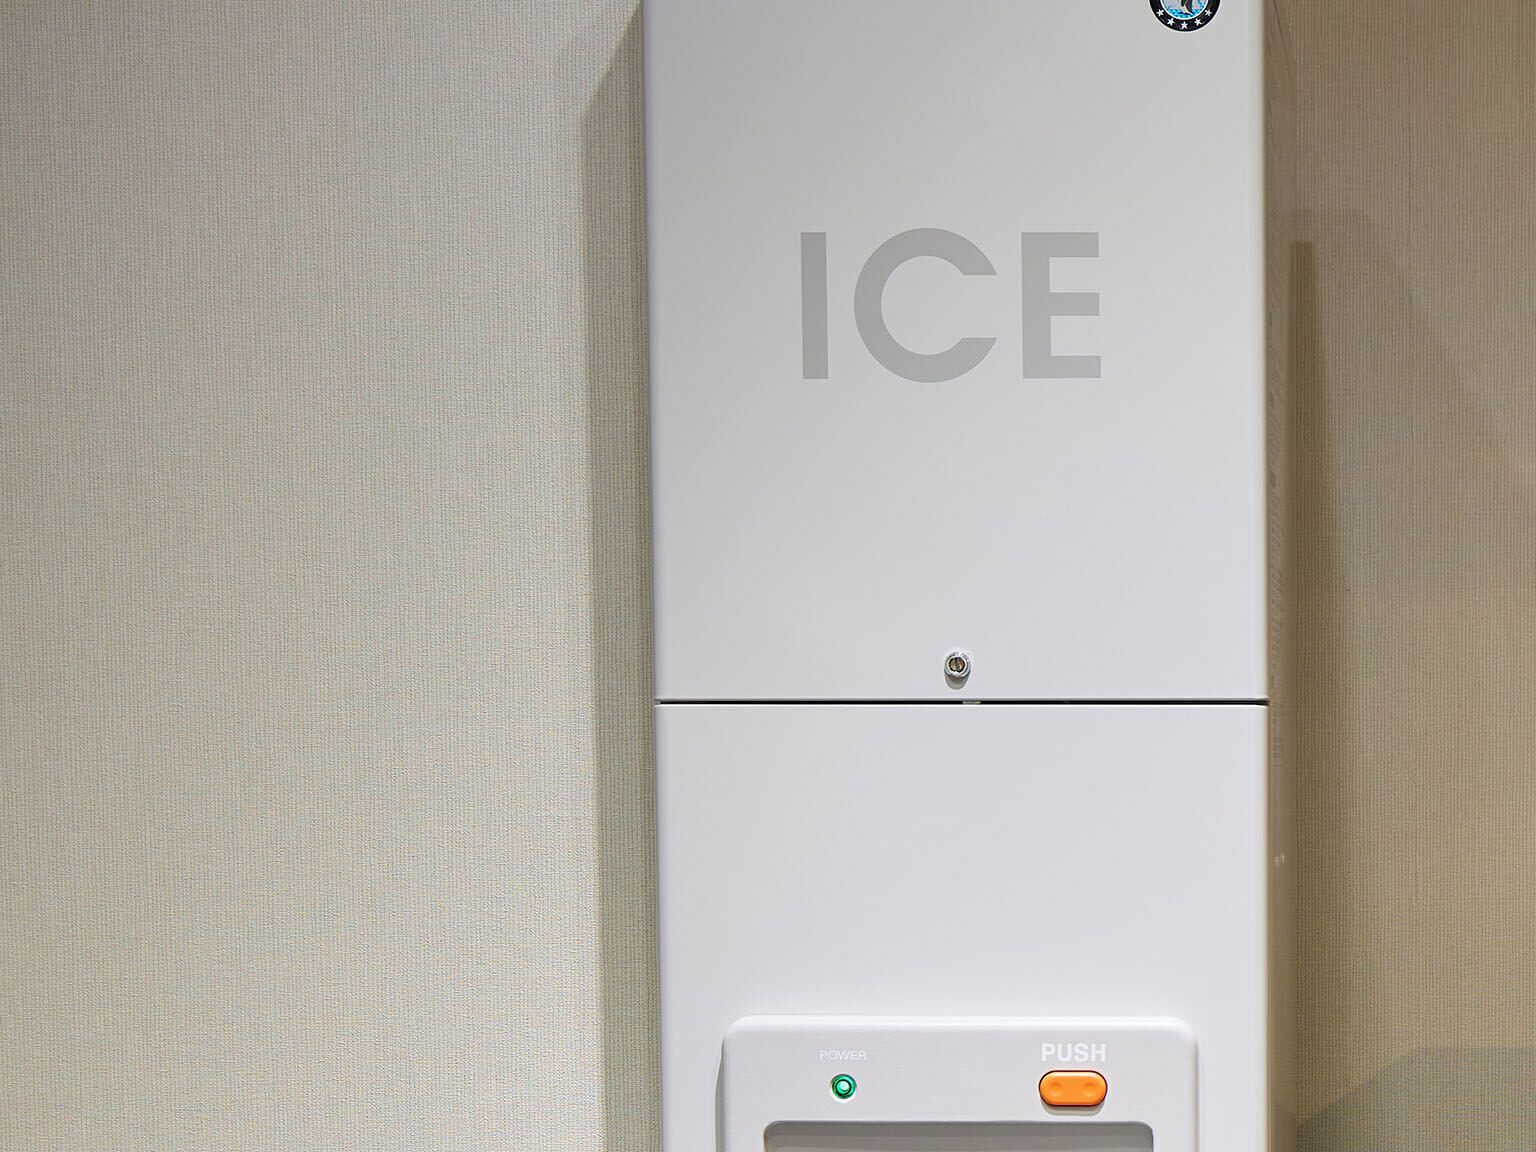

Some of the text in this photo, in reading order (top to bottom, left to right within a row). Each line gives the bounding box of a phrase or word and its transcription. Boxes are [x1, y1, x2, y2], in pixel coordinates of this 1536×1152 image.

[800, 228, 1102, 383] ICE
[819, 1050, 868, 1061] POWER
[1040, 1043, 1107, 1063] PUSH
